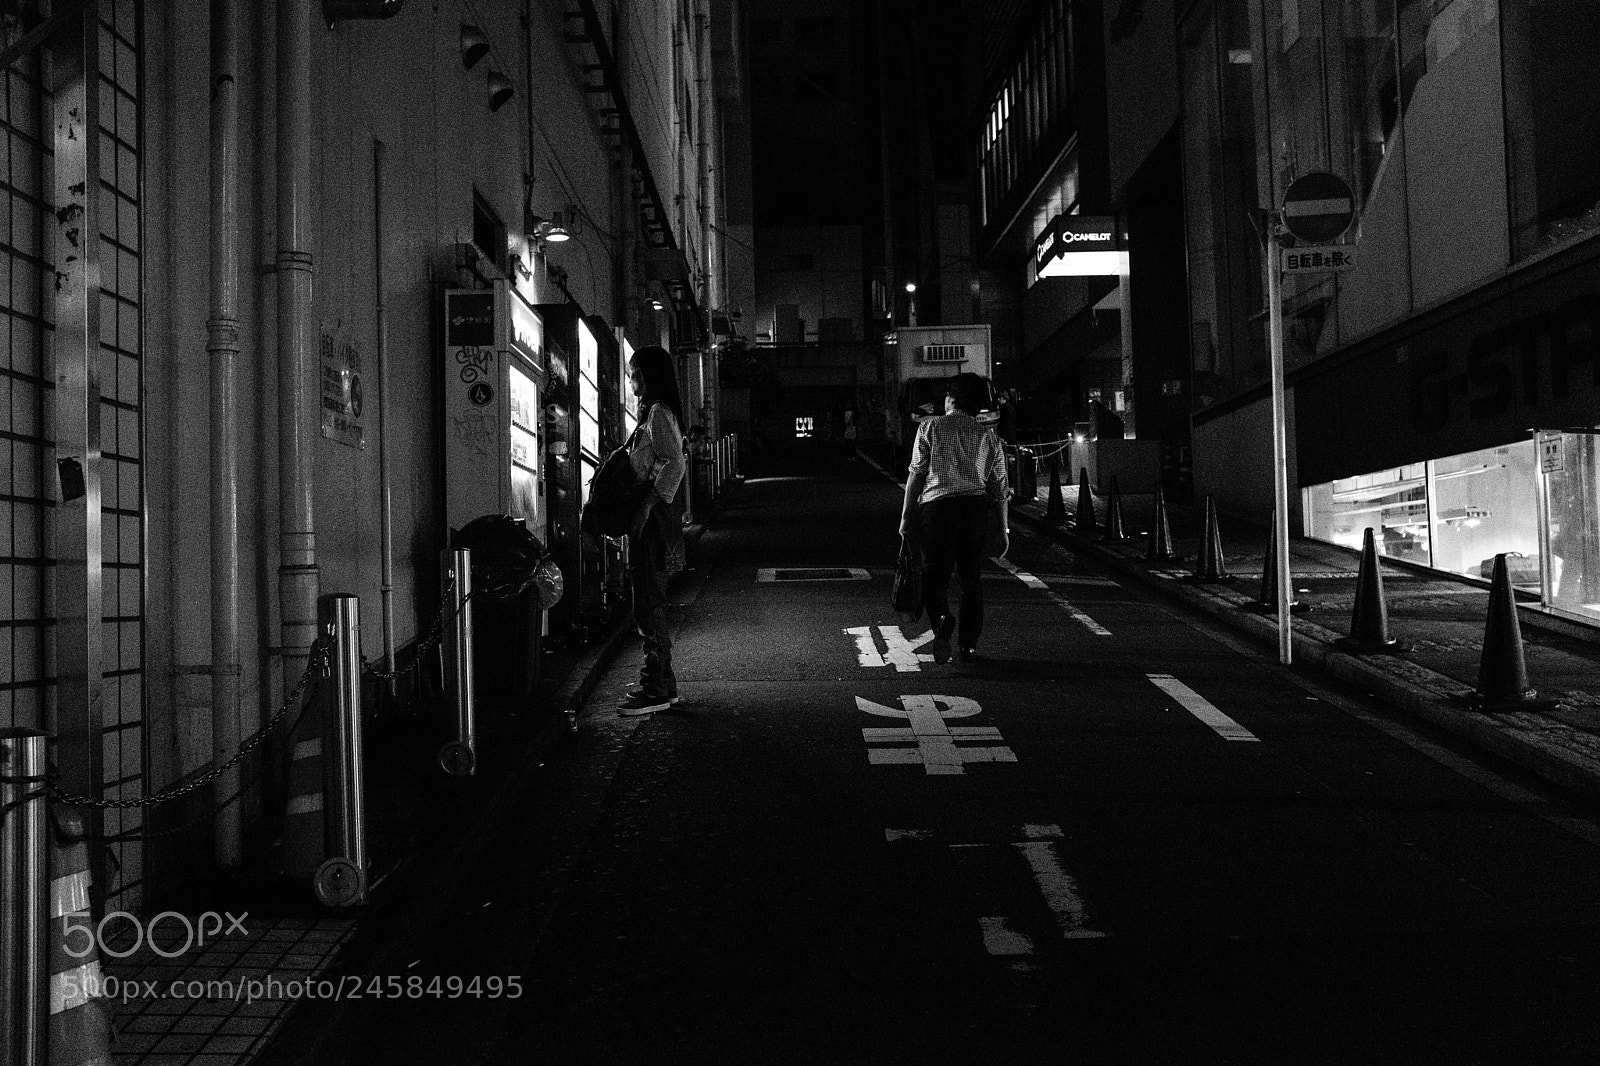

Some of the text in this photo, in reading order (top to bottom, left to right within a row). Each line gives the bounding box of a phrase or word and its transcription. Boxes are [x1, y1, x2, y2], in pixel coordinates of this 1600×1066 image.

[1073, 232, 1111, 241] CAMELOT
[1287, 251, 1352, 269] 自転車を除く
